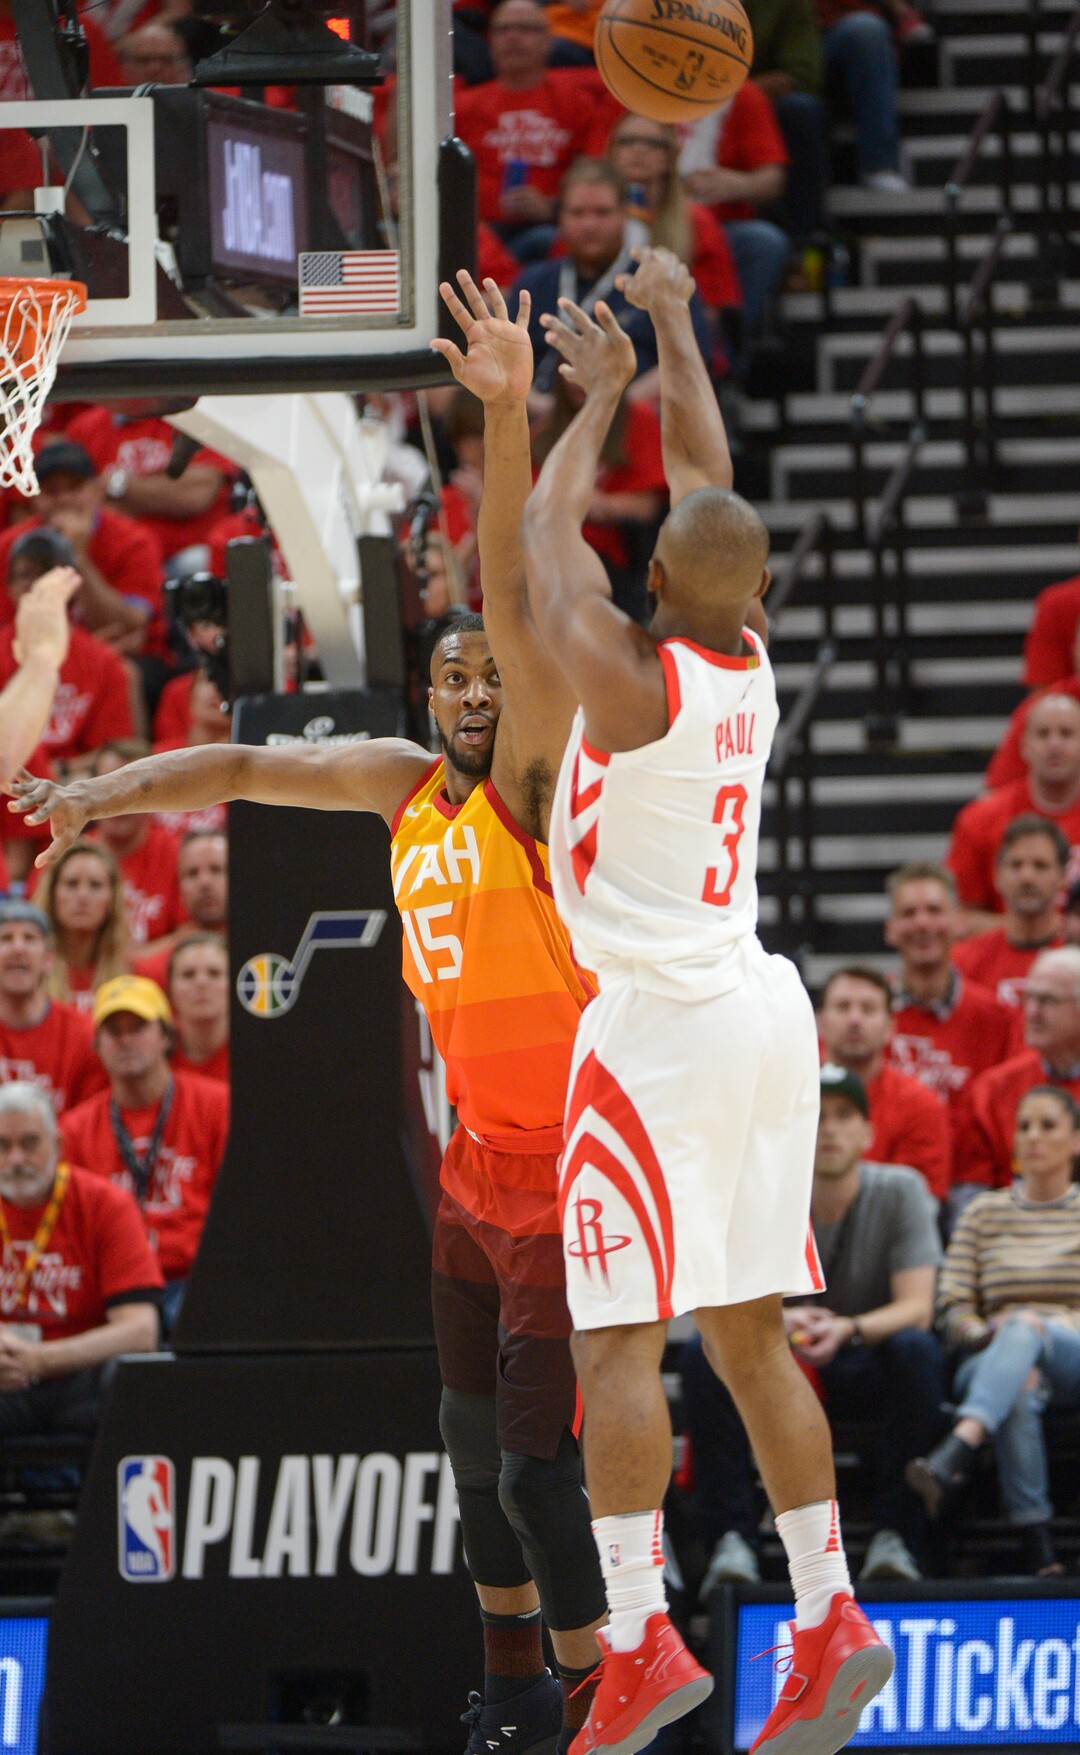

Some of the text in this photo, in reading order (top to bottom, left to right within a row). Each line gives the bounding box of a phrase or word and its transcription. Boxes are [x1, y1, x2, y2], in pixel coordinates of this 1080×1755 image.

[651, 0, 747, 55] SPALDING
[715, 712, 755, 763] PAUL
[391, 825, 480, 899] UTAH
[702, 783, 748, 906] 3
[402, 902, 463, 983] 15
[182, 1452, 468, 1579] PLAYOFF
